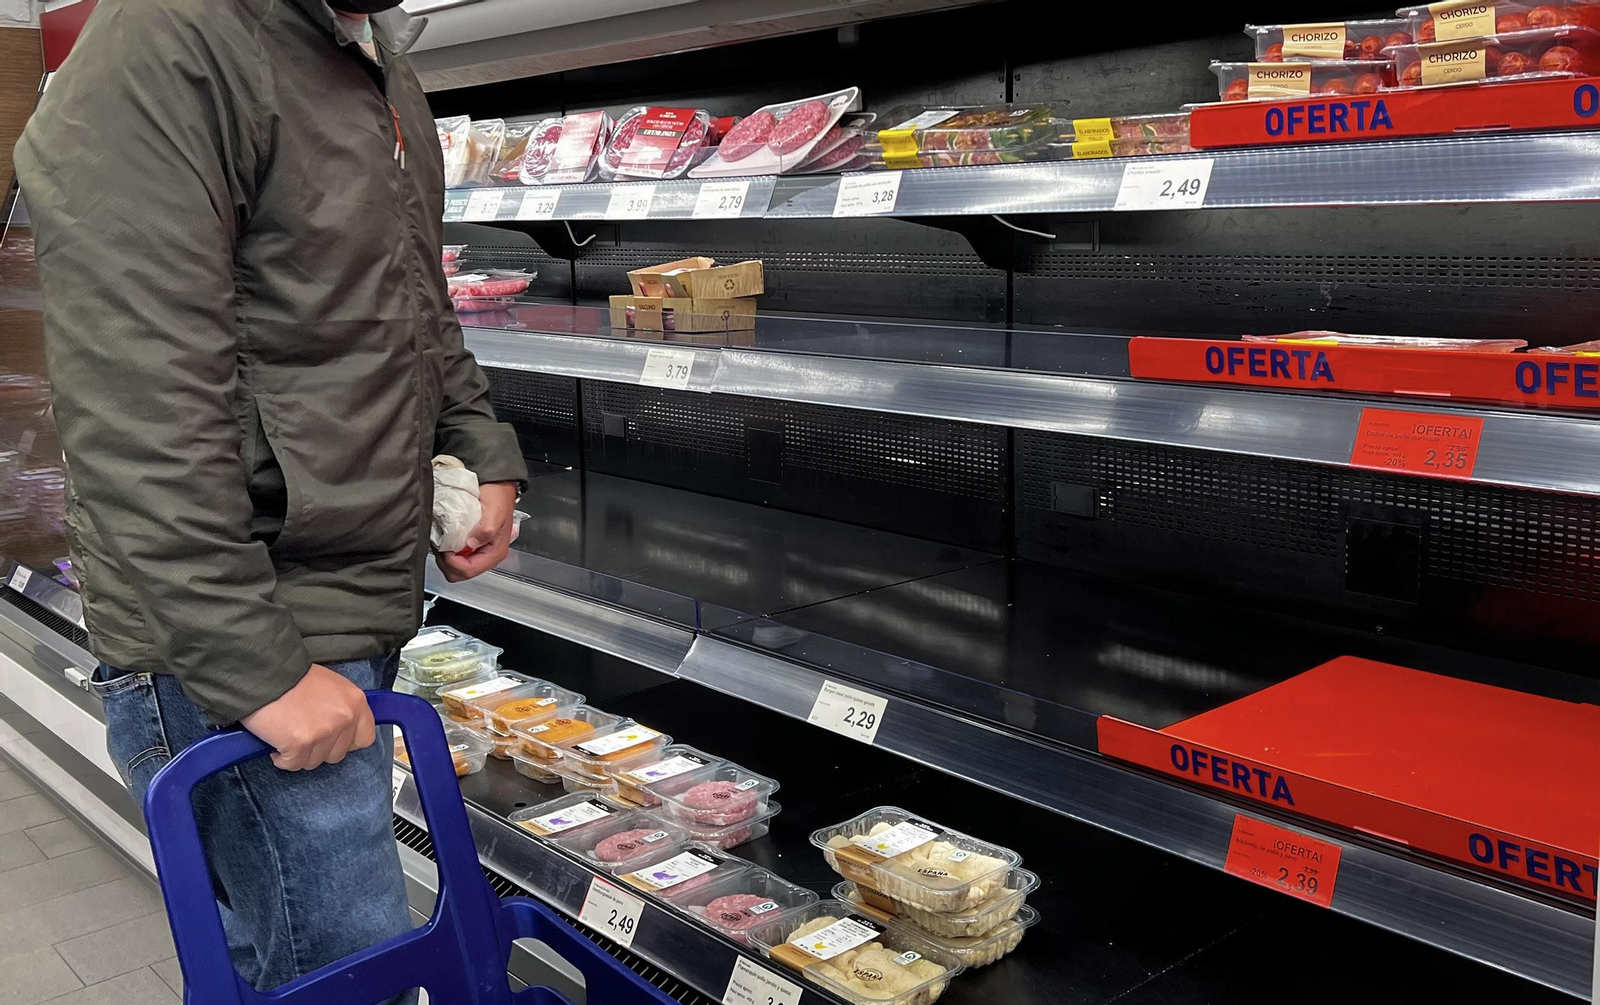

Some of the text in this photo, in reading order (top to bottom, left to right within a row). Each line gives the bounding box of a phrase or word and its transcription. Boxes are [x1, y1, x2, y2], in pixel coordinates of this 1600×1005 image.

[1440, 5, 1487, 20] CHORIZO
[1291, 32, 1338, 42] CHORIZO
[1428, 50, 1478, 63] CHORIZO
[1256, 70, 1303, 79] CHORIZO
[1265, 99, 1393, 136] OFERTA
[872, 190, 894, 204] 3,28
[1159, 178, 1201, 200] 2,49
[536, 202, 555, 215] 3,29
[627, 199, 648, 212] 3,99
[718, 195, 742, 211] 2,79
[665, 364, 688, 380] 3,79
[1205, 346, 1334, 382] OFERTA
[1515, 361, 1599, 398] OFE
[1412, 424, 1473, 439] ¡OFERTA!
[1384, 458, 1406, 467] -20%
[1423, 449, 1468, 469] 2,35
[843, 706, 876, 730] 2,29
[1170, 744, 1295, 806] OFERTA
[1273, 839, 1323, 864] ¡OFERTA!
[1468, 833, 1598, 896] OFERT
[1249, 867, 1268, 880] -20%
[1276, 867, 1319, 895] 2,39
[607, 909, 634, 934] 2,49
